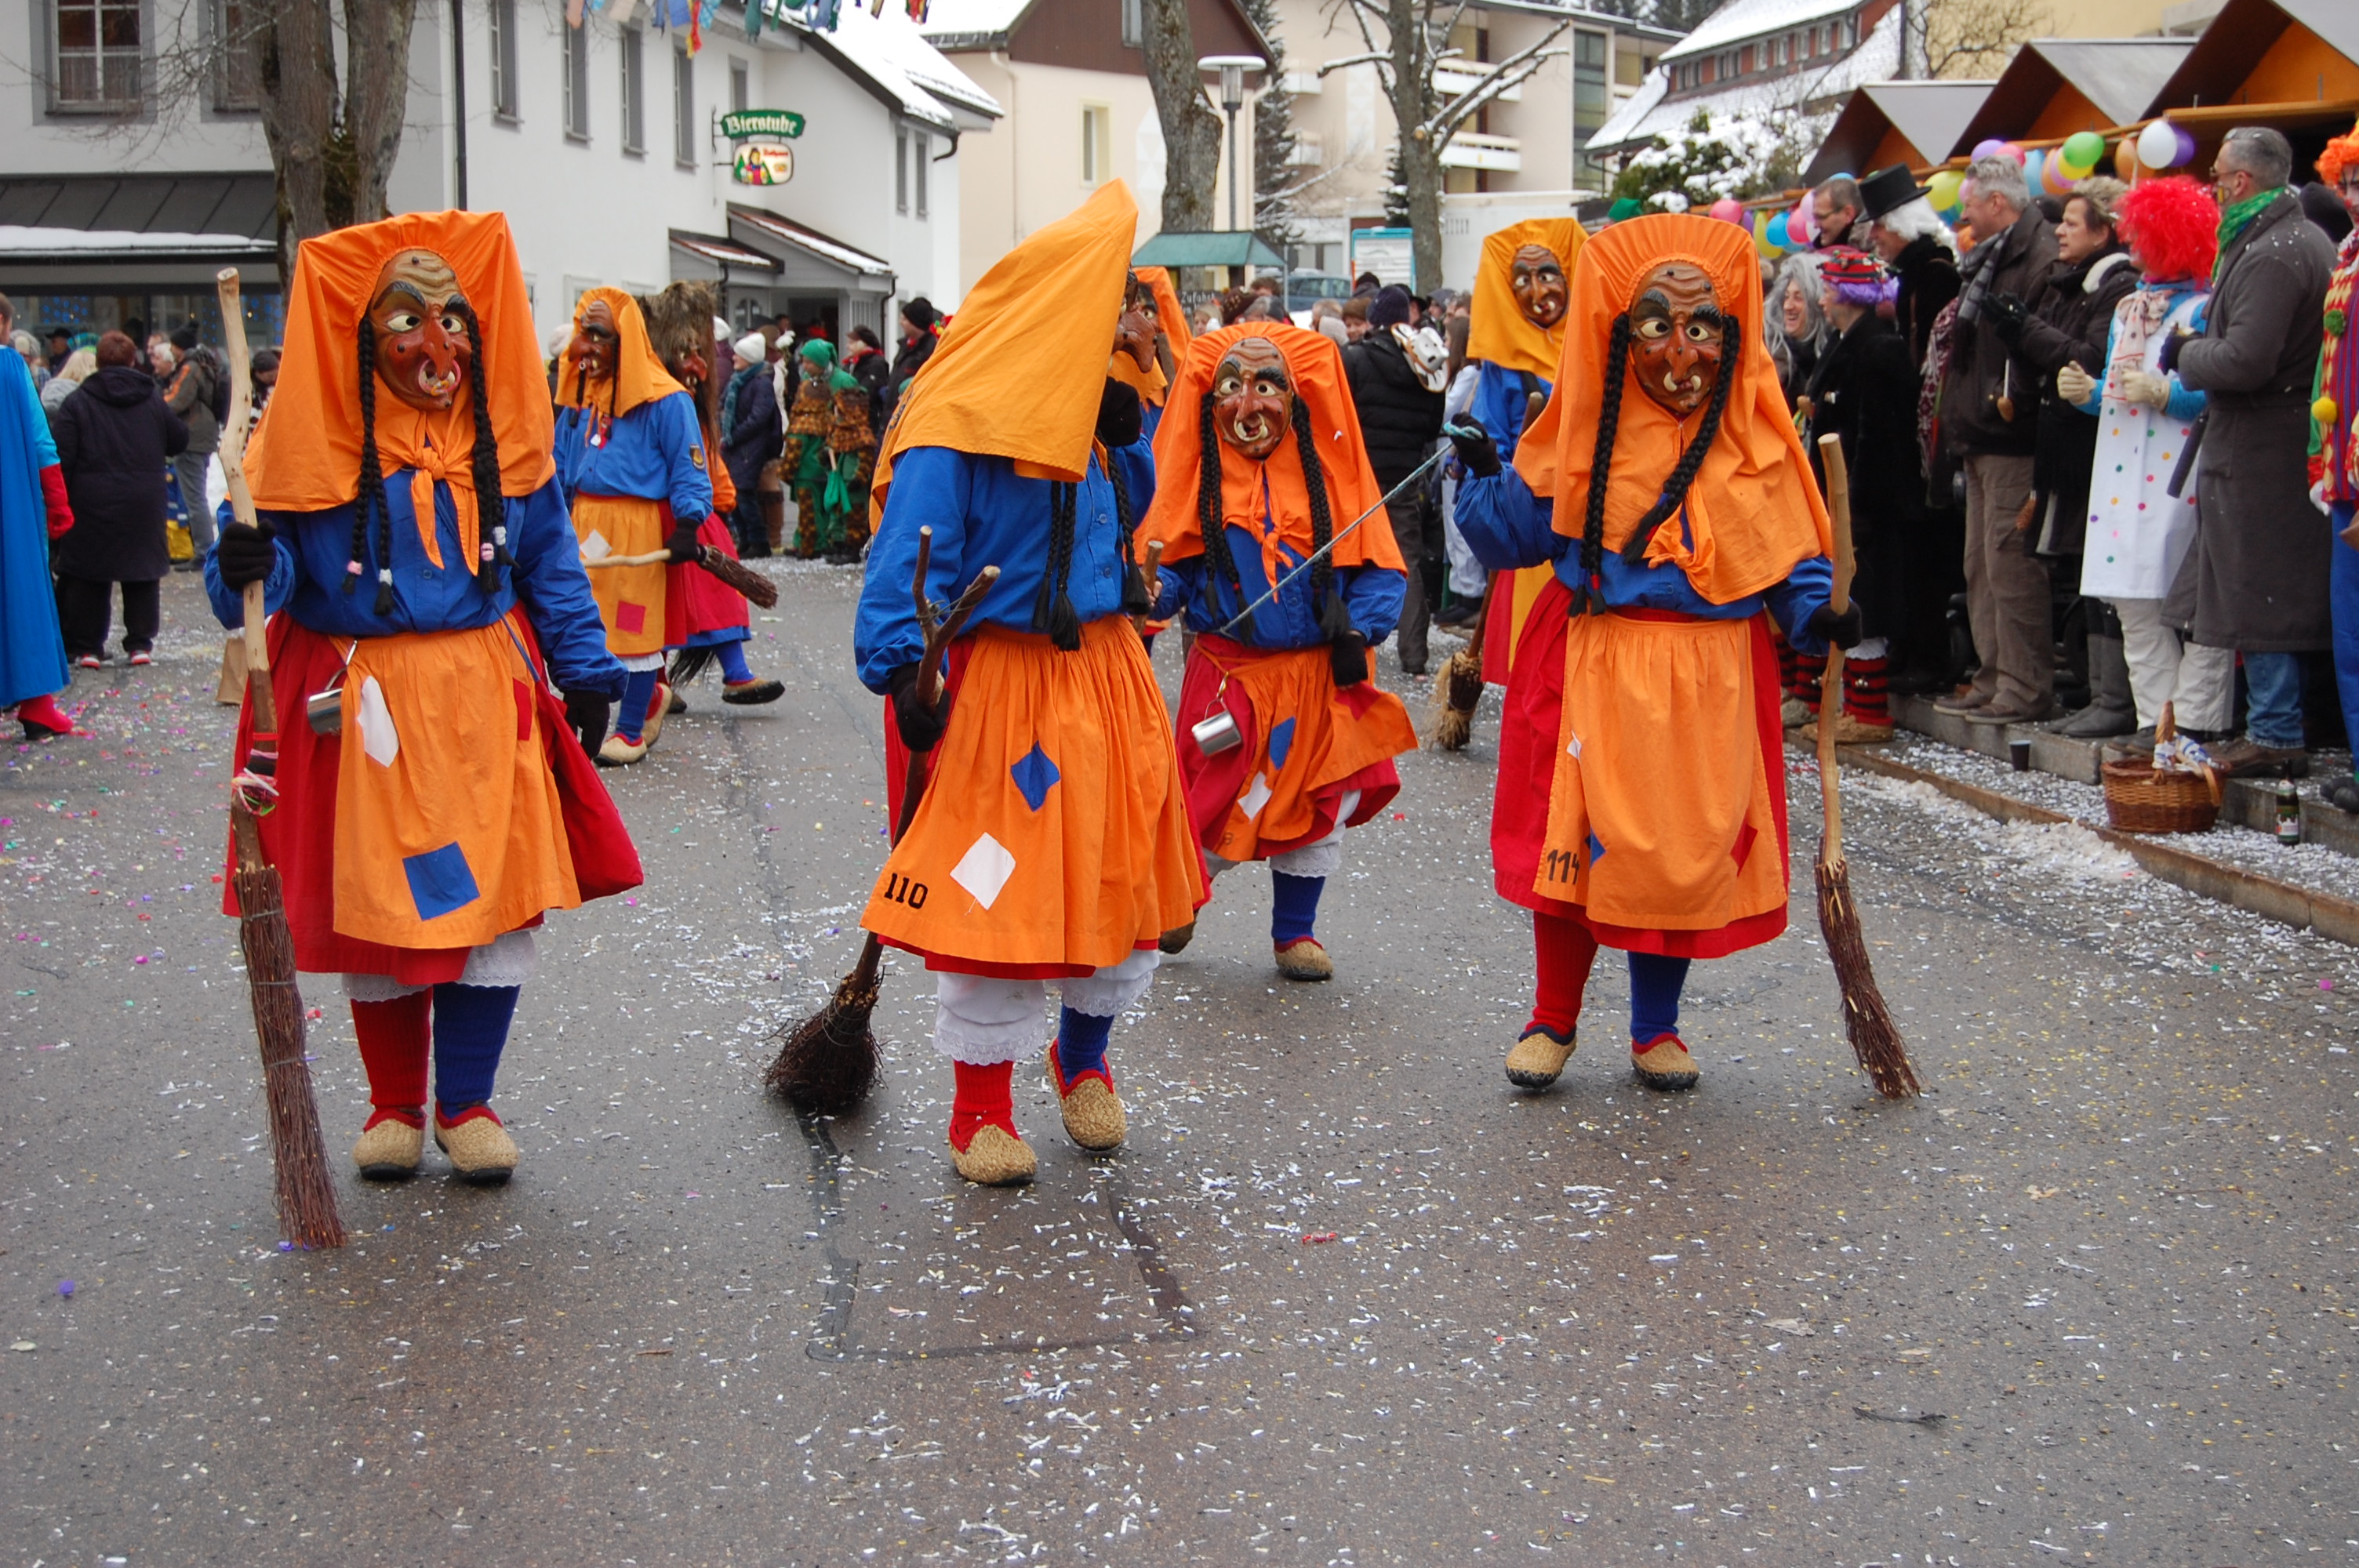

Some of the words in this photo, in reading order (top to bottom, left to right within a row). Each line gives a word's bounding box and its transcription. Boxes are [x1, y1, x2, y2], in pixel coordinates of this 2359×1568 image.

[725, 115, 797, 134] Bierstube
[1547, 849, 1580, 884] 114
[884, 873, 929, 909] 110
